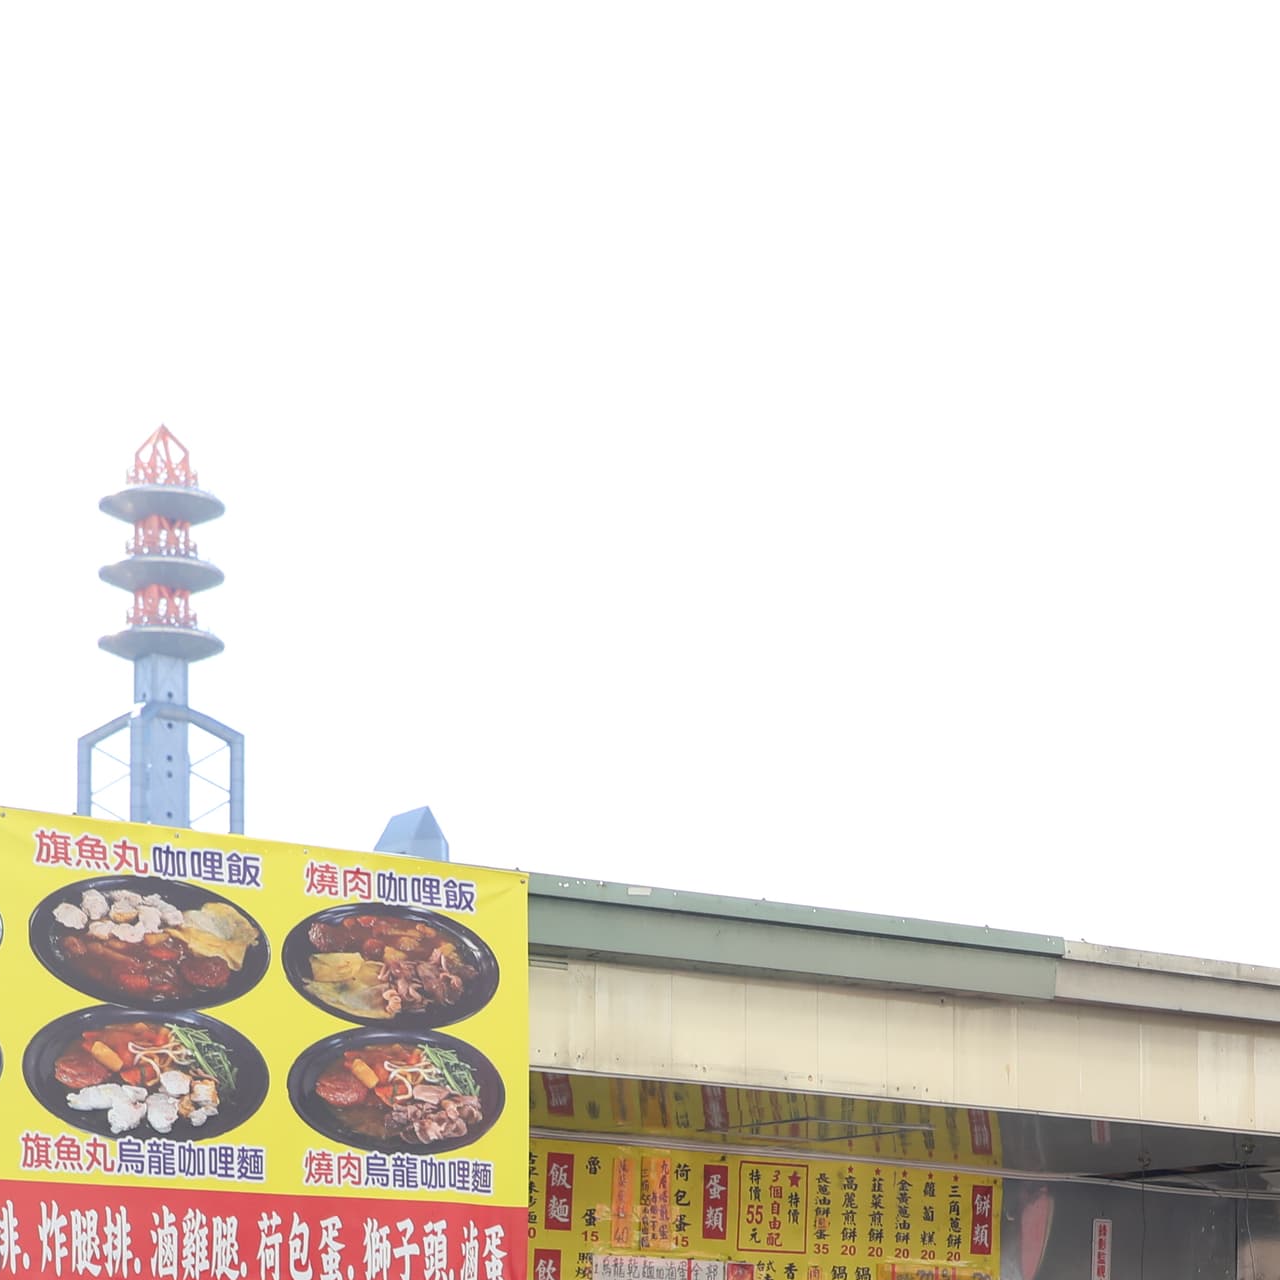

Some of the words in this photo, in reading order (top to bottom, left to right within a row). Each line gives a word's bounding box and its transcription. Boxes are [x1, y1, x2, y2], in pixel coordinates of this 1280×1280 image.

[33, 829, 262, 889] 旗魚丸咖哩飯
[304, 861, 477, 913] 燒肉咖哩飯
[21, 1131, 265, 1182] 旗魚丸烏龍咖哩麵
[303, 1149, 493, 1194] 燒肉烏龍咖哩麵
[548, 1162, 572, 1224] 飯麵
[673, 1163, 692, 1233] 荷包蛋
[705, 1174, 727, 1233] 蛋類
[766, 1169, 783, 1248] 3個自由配
[787, 1192, 800, 1225] 特價
[840, 1175, 858, 1243] 高麗煎餅
[582, 1230, 600, 1242] 15
[673, 1235, 690, 1248] 15
[972, 1192, 991, 1249] 餅類
[813, 1243, 830, 1255] 35
[840, 1244, 857, 1256] 20
[867, 1246, 884, 1258] 20
[894, 1247, 910, 1260] 20
[920, 1249, 936, 1261] 20
[946, 1251, 961, 1262] 20
